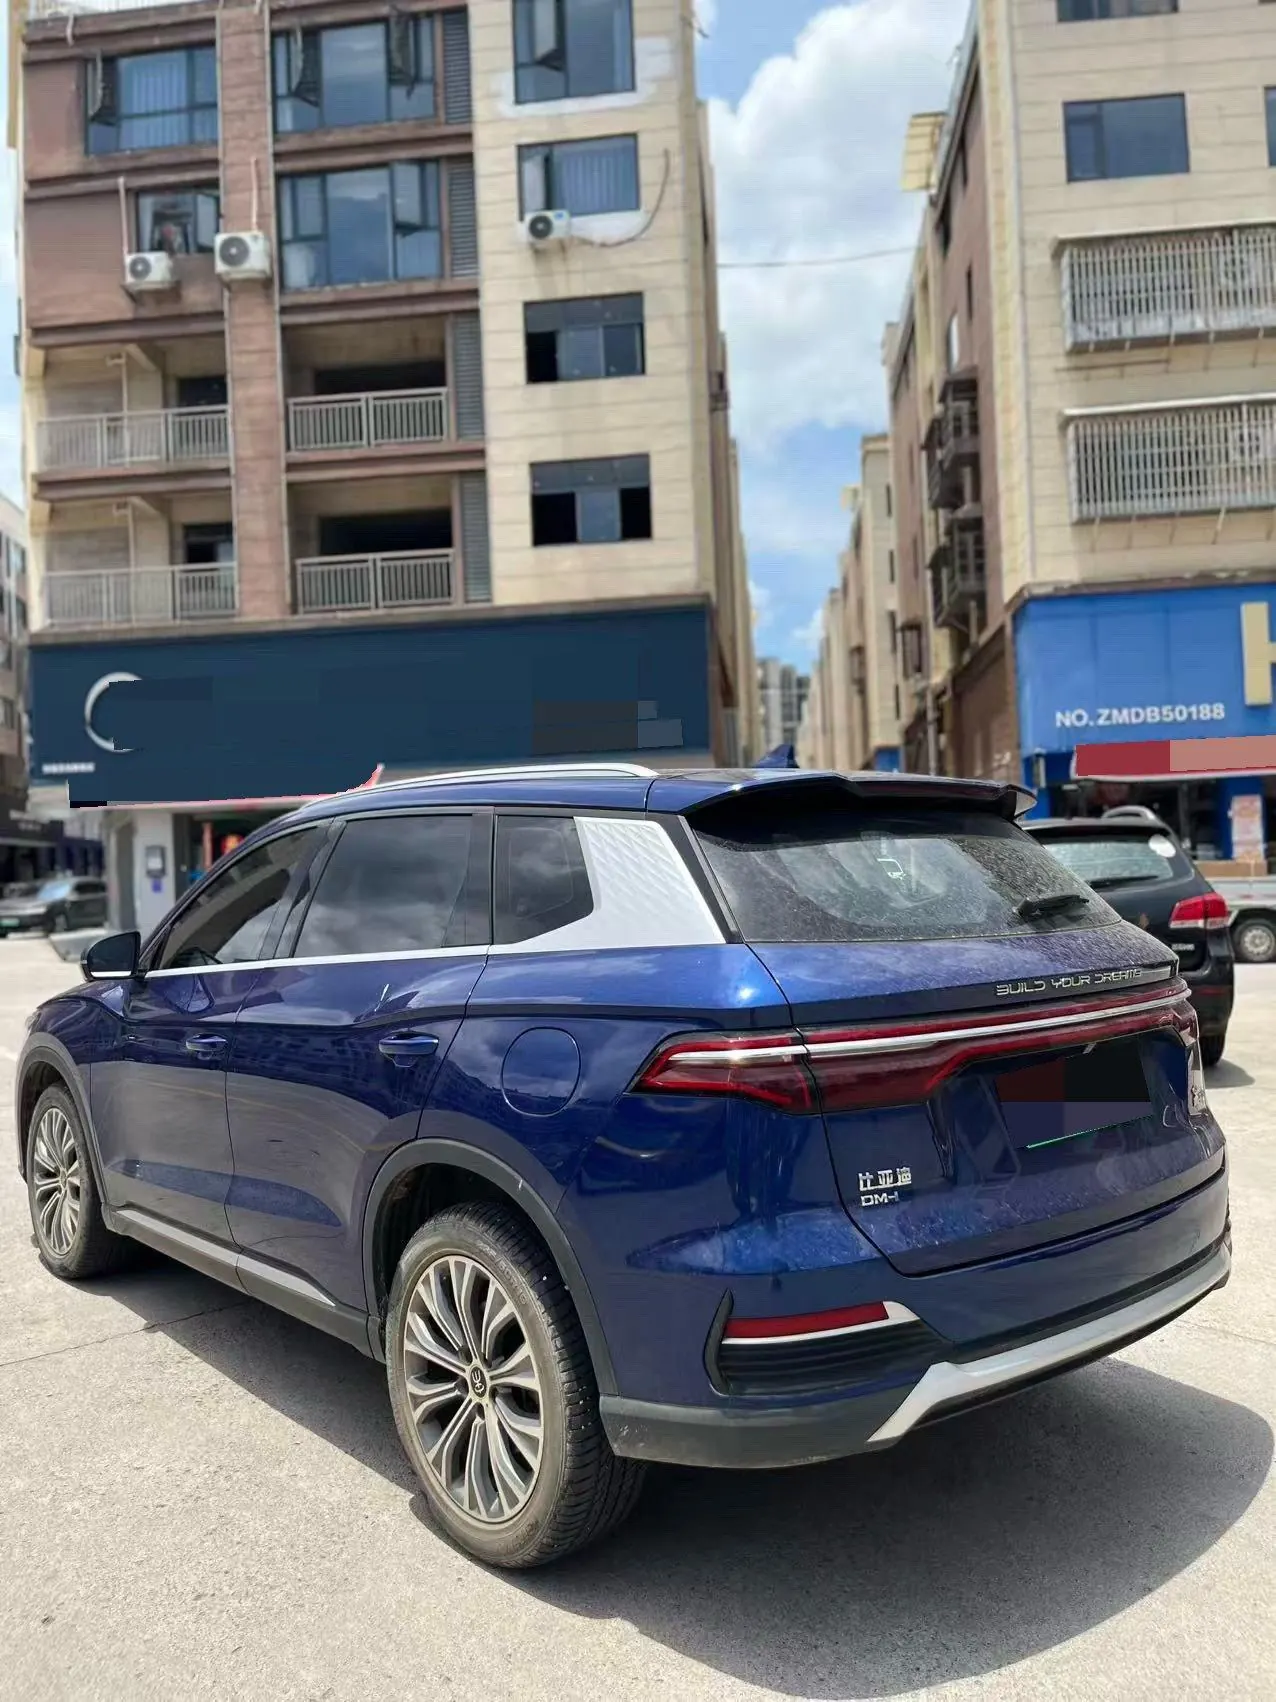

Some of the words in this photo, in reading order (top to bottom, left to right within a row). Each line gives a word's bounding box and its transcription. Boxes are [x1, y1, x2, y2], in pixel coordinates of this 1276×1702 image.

[996, 981, 1046, 996] BUILD
[1051, 974, 1090, 989] YOUR
[1094, 968, 1142, 984] DREAMS
[858, 1167, 912, 1191] 比亚迪
